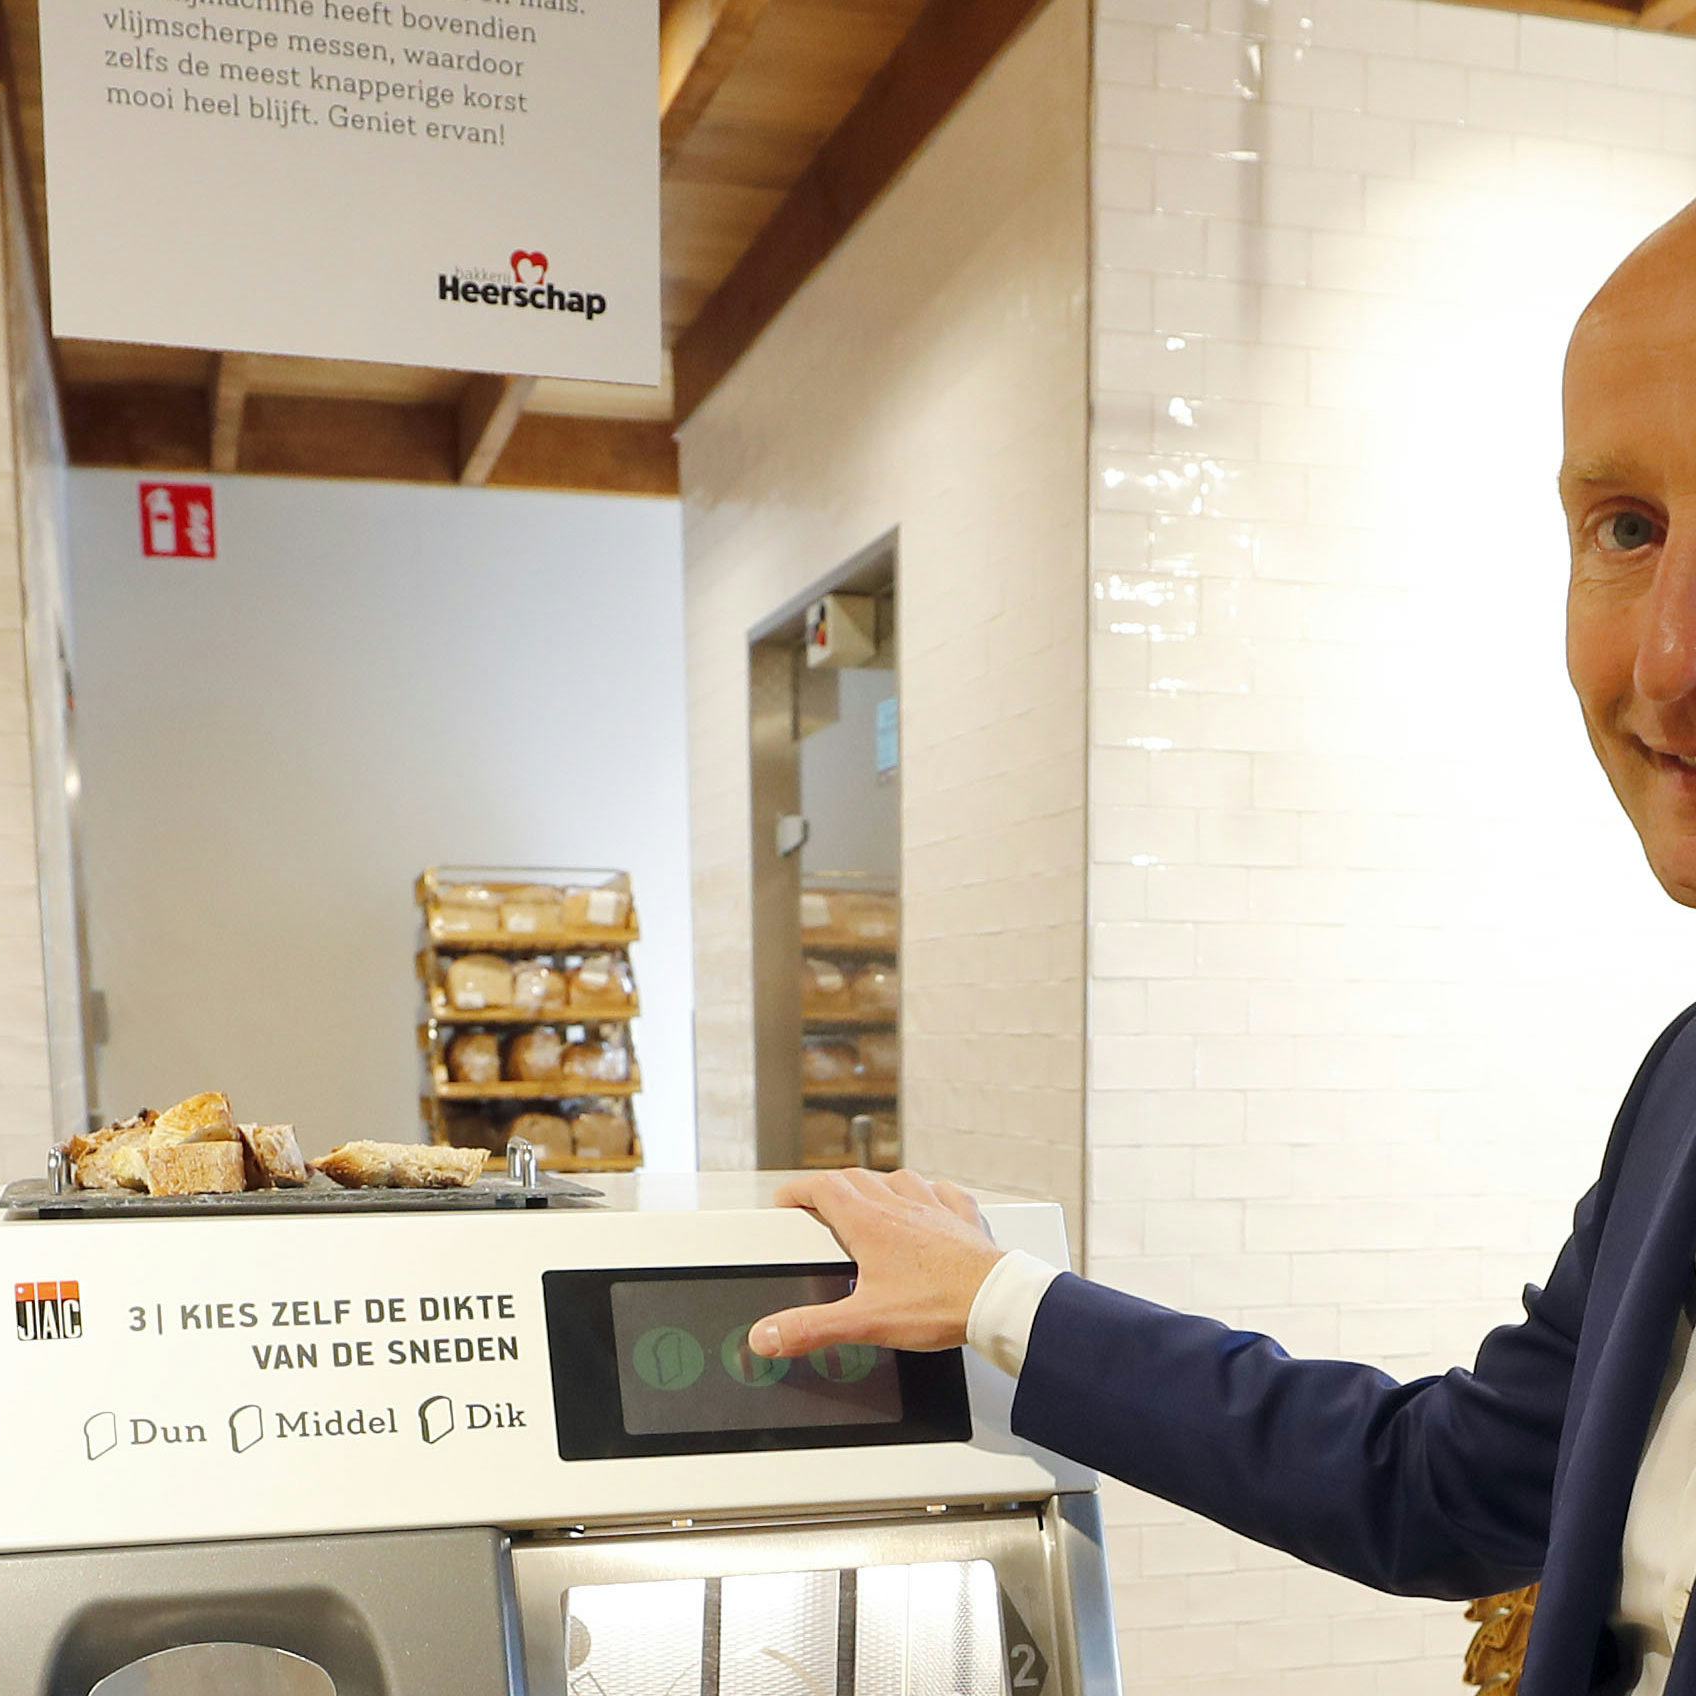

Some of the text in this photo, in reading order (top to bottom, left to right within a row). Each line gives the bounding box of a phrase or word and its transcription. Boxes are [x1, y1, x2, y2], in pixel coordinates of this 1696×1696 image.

[103, 8, 278, 51] vlijmscherpe
[288, 34, 395, 65] messen,
[404, 44, 525, 77] waardoor
[324, 0, 392, 25] heeft
[402, 4, 538, 43] bovendien
[104, 46, 529, 113] zelfs de meest knapperige korst
[105, 82, 506, 146] mooi heel blijft. Geniet ervan!
[438, 273, 607, 320] Heerschap
[16, 1299, 83, 1341] JAC
[181, 1301, 259, 1330] KIES
[271, 1299, 352, 1328] ZELF
[365, 1298, 407, 1324] DE
[420, 1294, 516, 1323] DIKTE
[251, 1336, 520, 1370] VAN DE SNEDEN
[129, 1418, 207, 1446] Dun
[275, 1407, 400, 1439] Middel
[465, 1401, 527, 1431] Dik
[1010, 1643, 1040, 1688] 2
